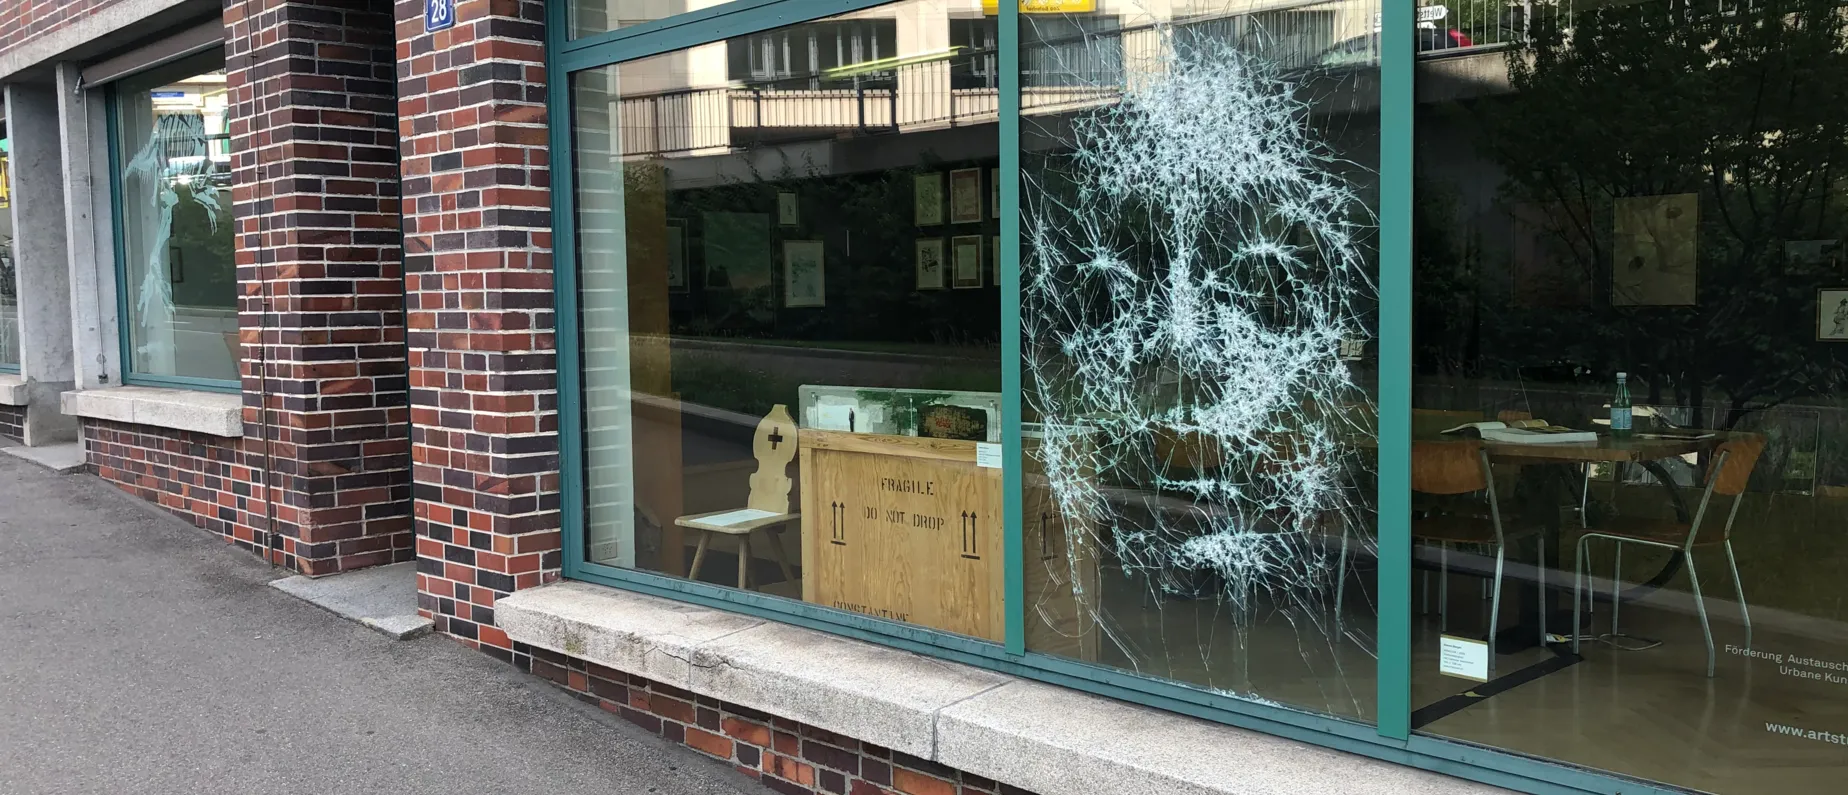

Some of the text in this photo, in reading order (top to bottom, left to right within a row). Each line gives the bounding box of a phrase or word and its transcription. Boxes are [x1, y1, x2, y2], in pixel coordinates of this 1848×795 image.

[431, 0, 447, 23] 28
[881, 477, 934, 496] FRAGILE
[864, 506, 945, 531] DO NOT DROP
[1725, 644, 1848, 672] Förderung Austausch
[1779, 665, 1822, 680] Urbane
